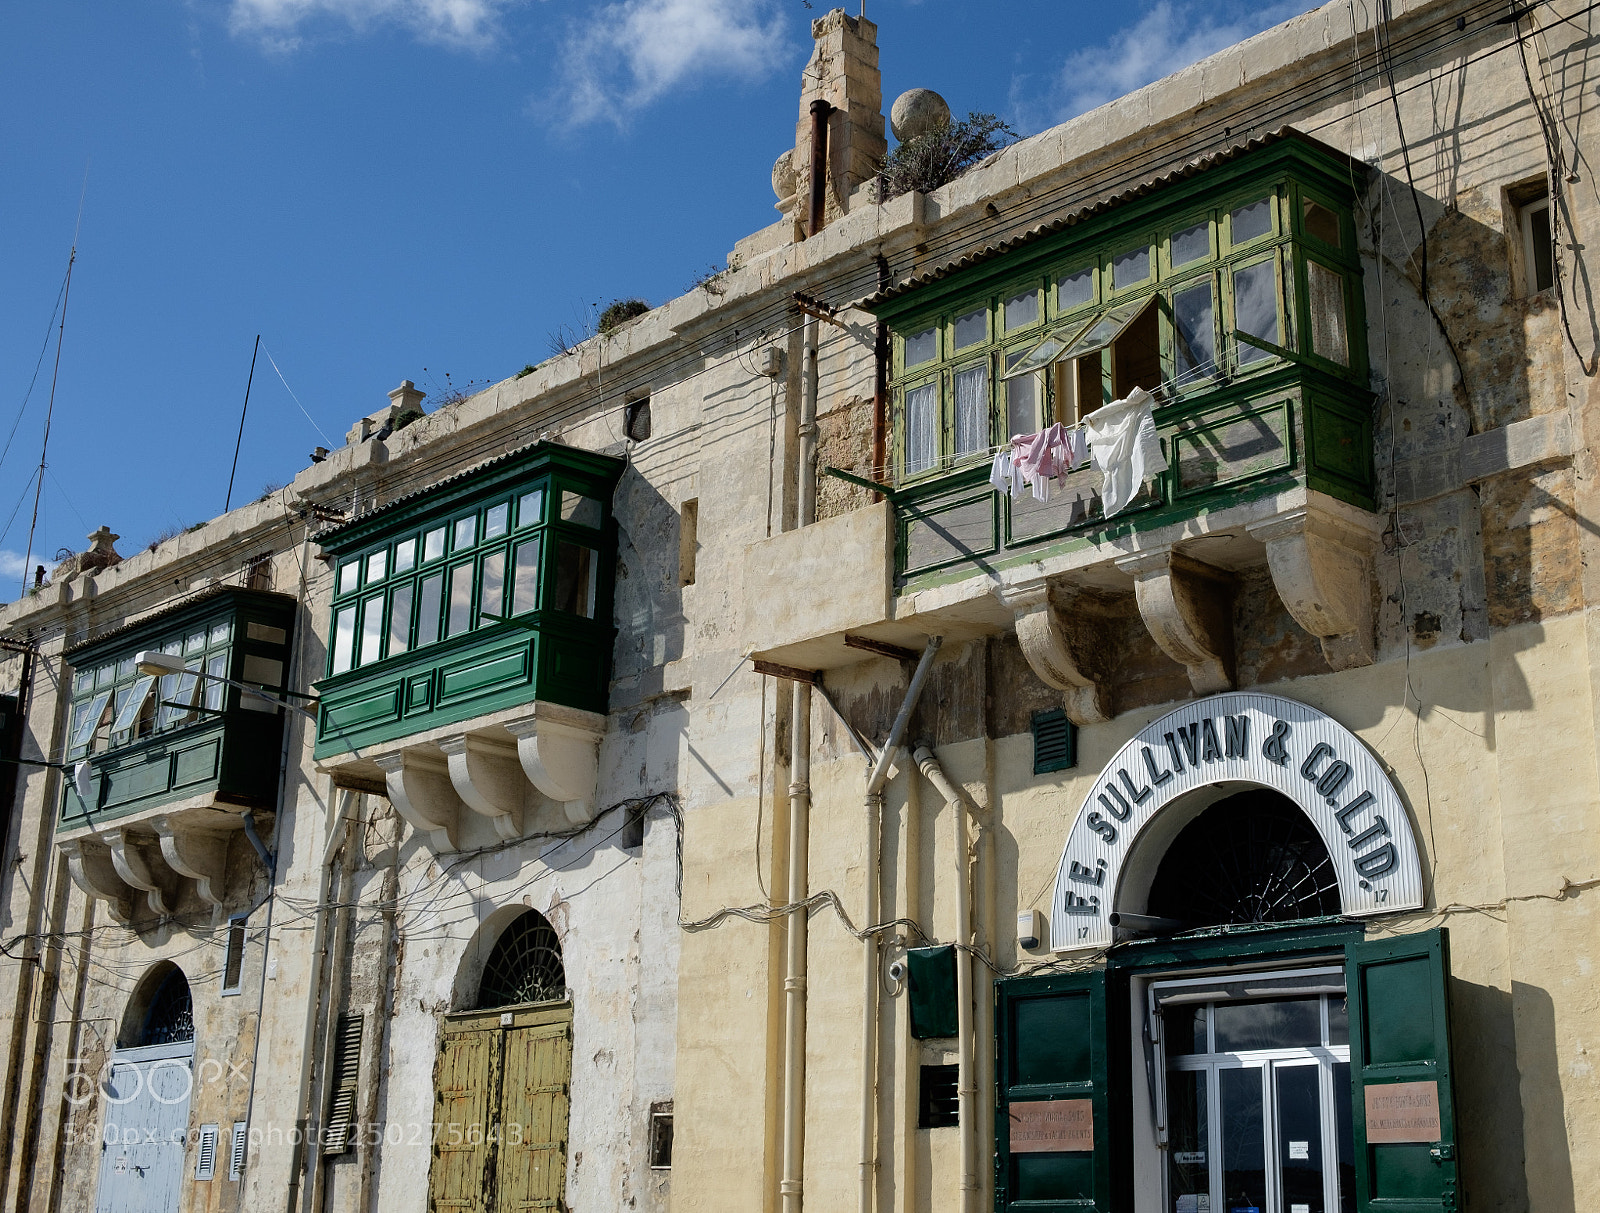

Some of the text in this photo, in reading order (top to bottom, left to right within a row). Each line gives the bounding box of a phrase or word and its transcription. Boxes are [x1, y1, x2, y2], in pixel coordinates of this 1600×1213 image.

[1087, 715, 1247, 842] SULLIVAN
[1263, 719, 1287, 766] &
[1373, 888, 1388, 903] 17
[1078, 926, 1089, 939] 17
